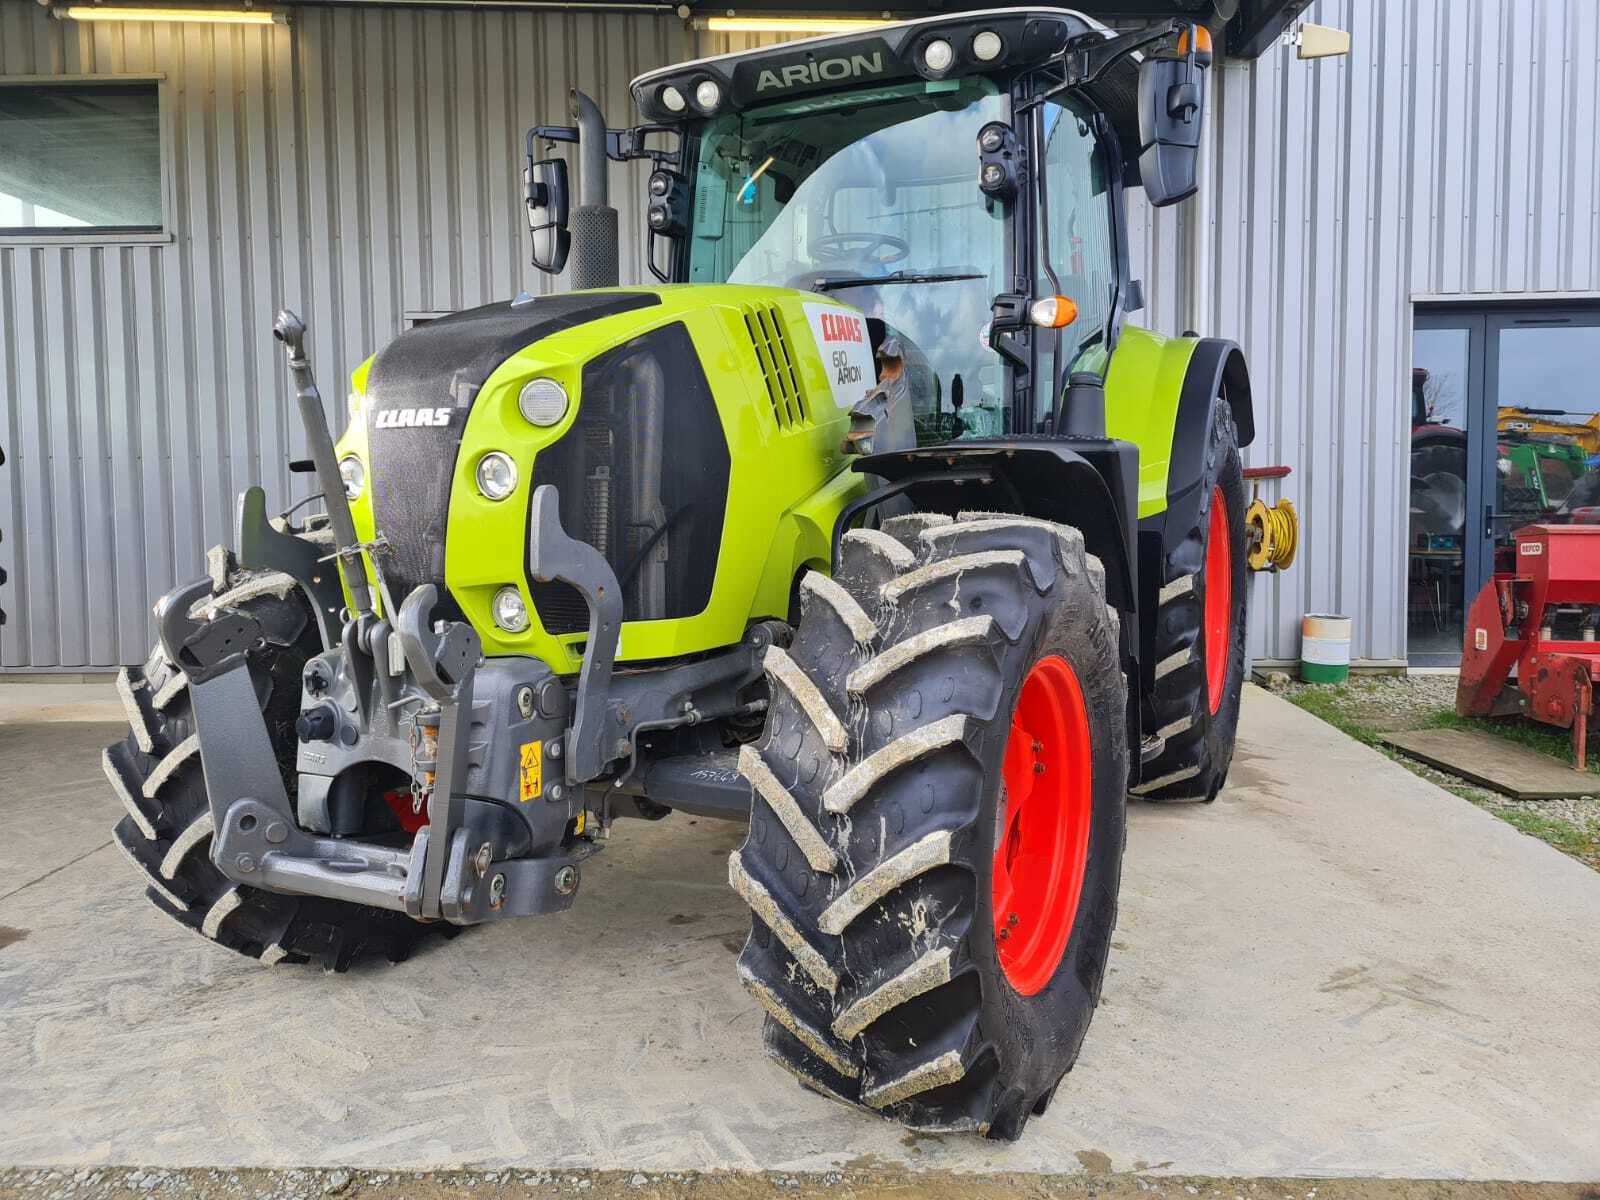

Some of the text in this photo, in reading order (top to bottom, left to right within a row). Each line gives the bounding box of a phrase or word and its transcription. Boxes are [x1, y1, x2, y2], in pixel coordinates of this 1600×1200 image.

[820, 313, 863, 343] CLAAS
[832, 350, 848, 368] 610
[837, 366, 862, 385] ARION
[375, 407, 452, 428] CLAAS
